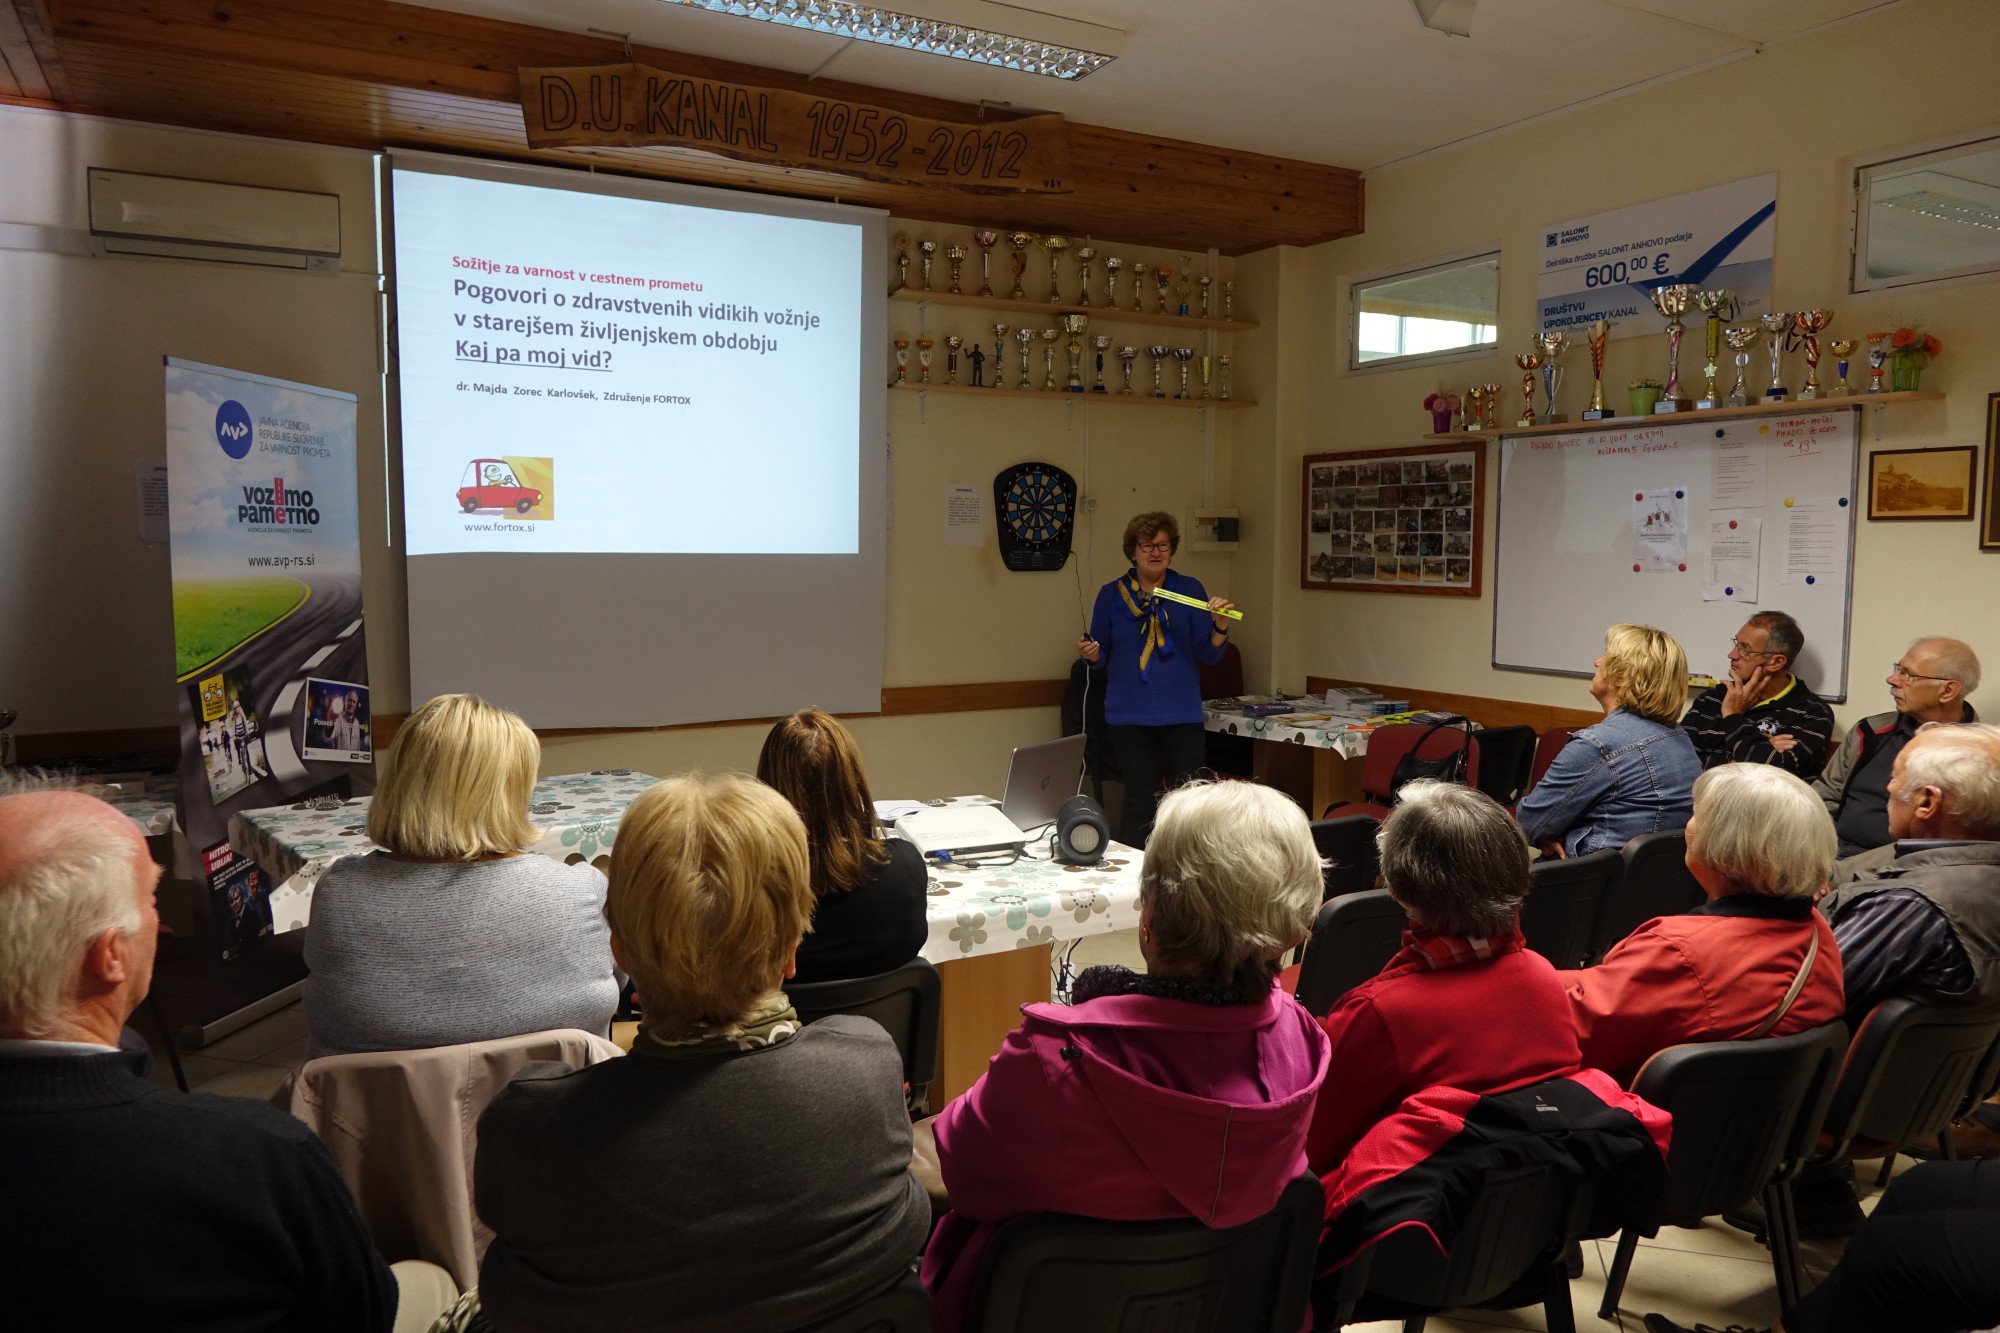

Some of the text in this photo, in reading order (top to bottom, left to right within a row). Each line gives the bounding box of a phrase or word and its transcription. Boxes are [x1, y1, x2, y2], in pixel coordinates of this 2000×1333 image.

[540, 75, 1028, 178] D.U. KANAL 1952-2012
[1560, 226, 1590, 238] SALONIT
[1560, 234, 1590, 244] ANHOVO
[1546, 232, 1692, 268] Delniška družba SALONIT ANHOVO podarja
[452, 256, 704, 293] Sožitje za varnost v cestnem prometu
[1652, 252, 1670, 276] €
[454, 278, 820, 328] Pogovori o zdravstvenih vidikih vožnje
[1544, 302, 1586, 316] DRUŠTVU
[1544, 311, 1608, 329] UPOKOJENCEV
[1608, 306, 1639, 318] KANAL
[454, 313, 778, 354] v starejšem življenjskem obdobju
[456, 340, 612, 368] Kaj pa moj vid?
[456, 382, 692, 405] dr. Majda Zorec Karlovšek, Združenje FORTOX
[259, 442, 268, 452] ZA
[302, 447, 331, 458] PROMETA
[464, 522, 535, 532] www.fortox.si
[248, 554, 315, 569] www.avp-rs.si
